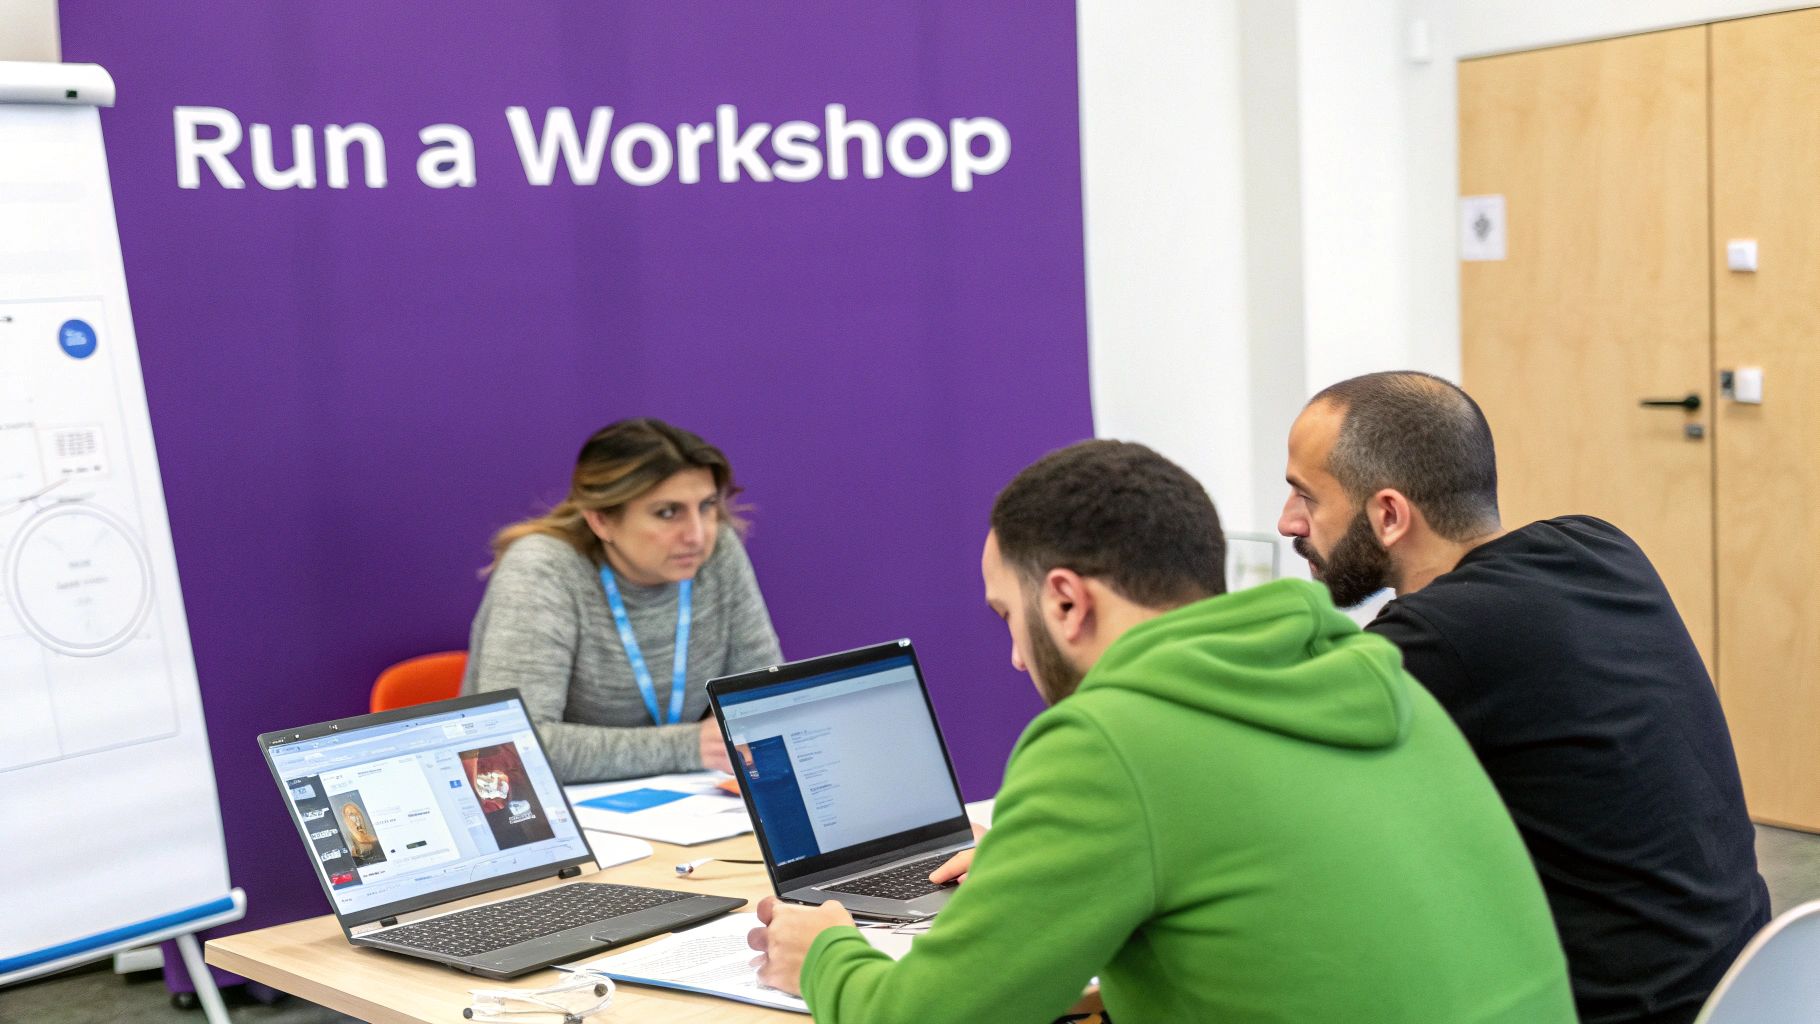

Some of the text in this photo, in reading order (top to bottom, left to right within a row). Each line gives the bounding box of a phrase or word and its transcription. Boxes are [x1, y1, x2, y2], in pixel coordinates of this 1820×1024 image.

[173, 103, 1013, 192] Run a Workshop
